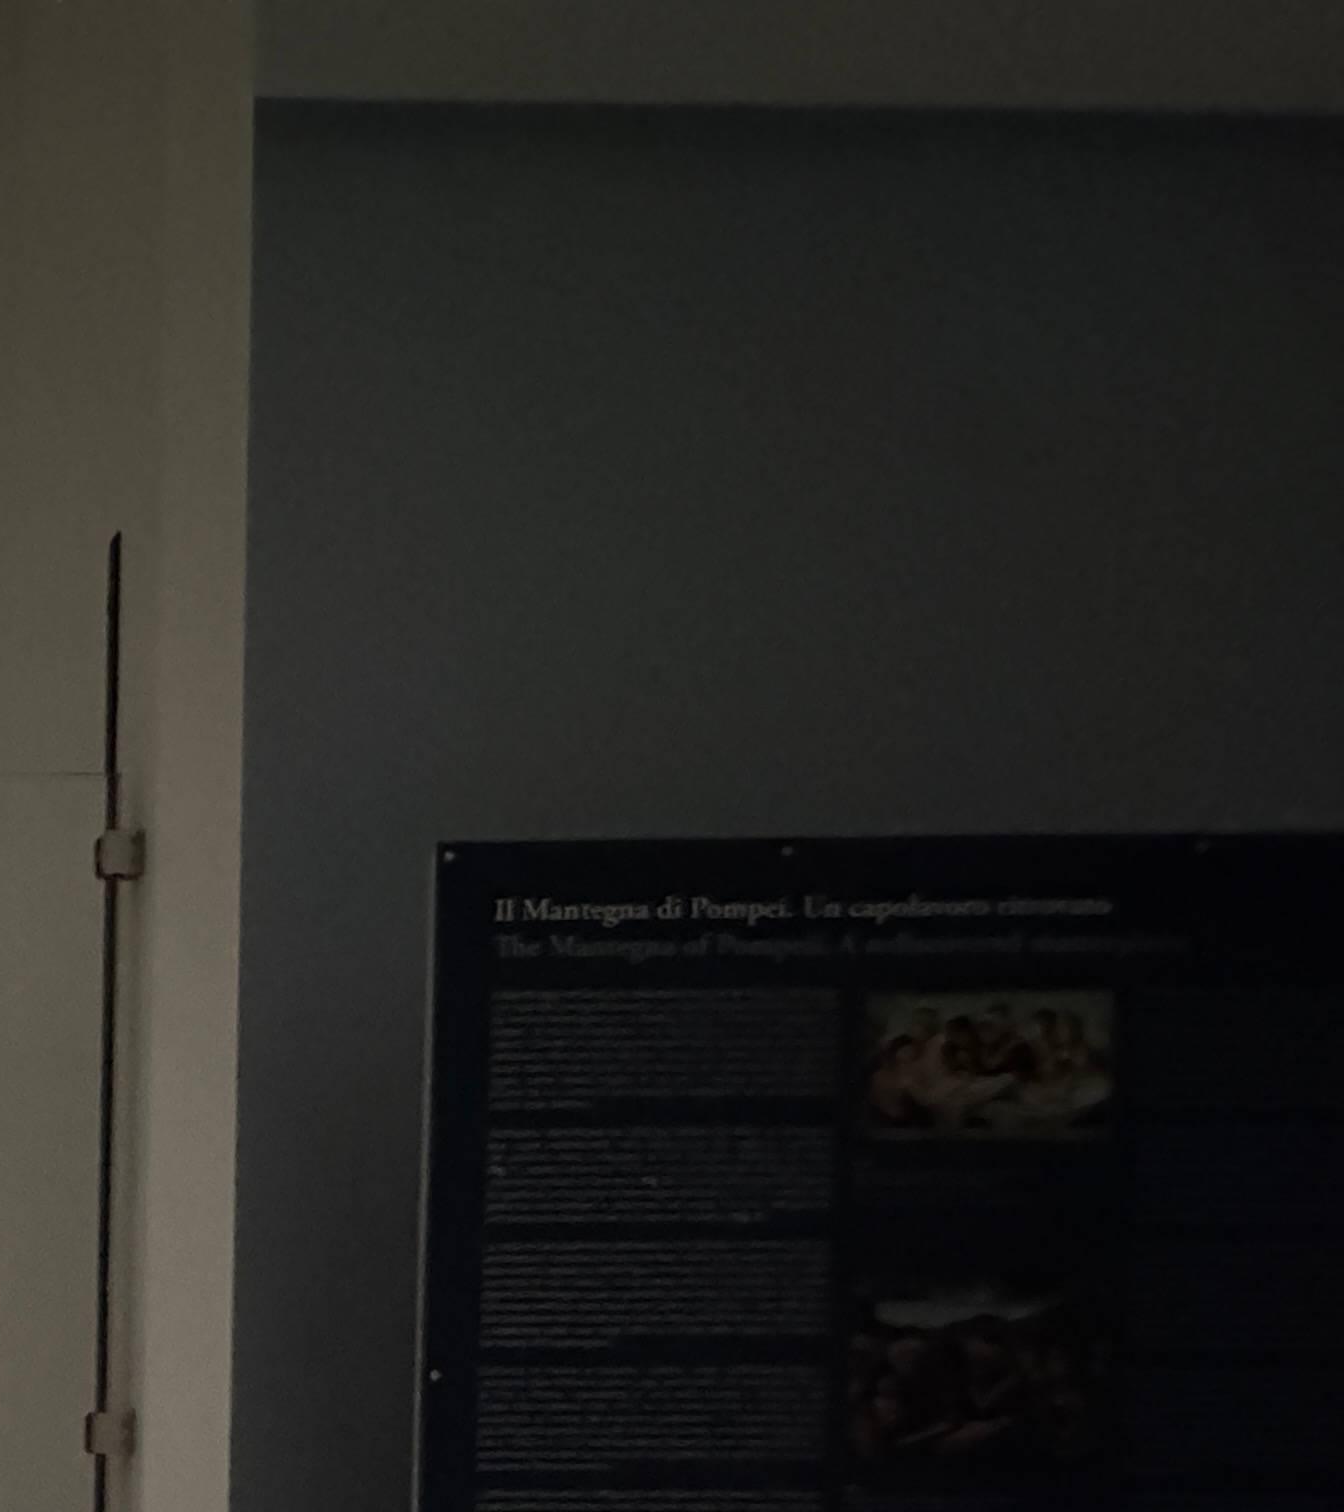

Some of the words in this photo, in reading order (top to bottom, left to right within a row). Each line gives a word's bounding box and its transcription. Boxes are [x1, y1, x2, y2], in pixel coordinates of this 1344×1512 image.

[495, 898, 514, 922] Il
[523, 897, 649, 928] Mantegna
[656, 895, 682, 920] di
